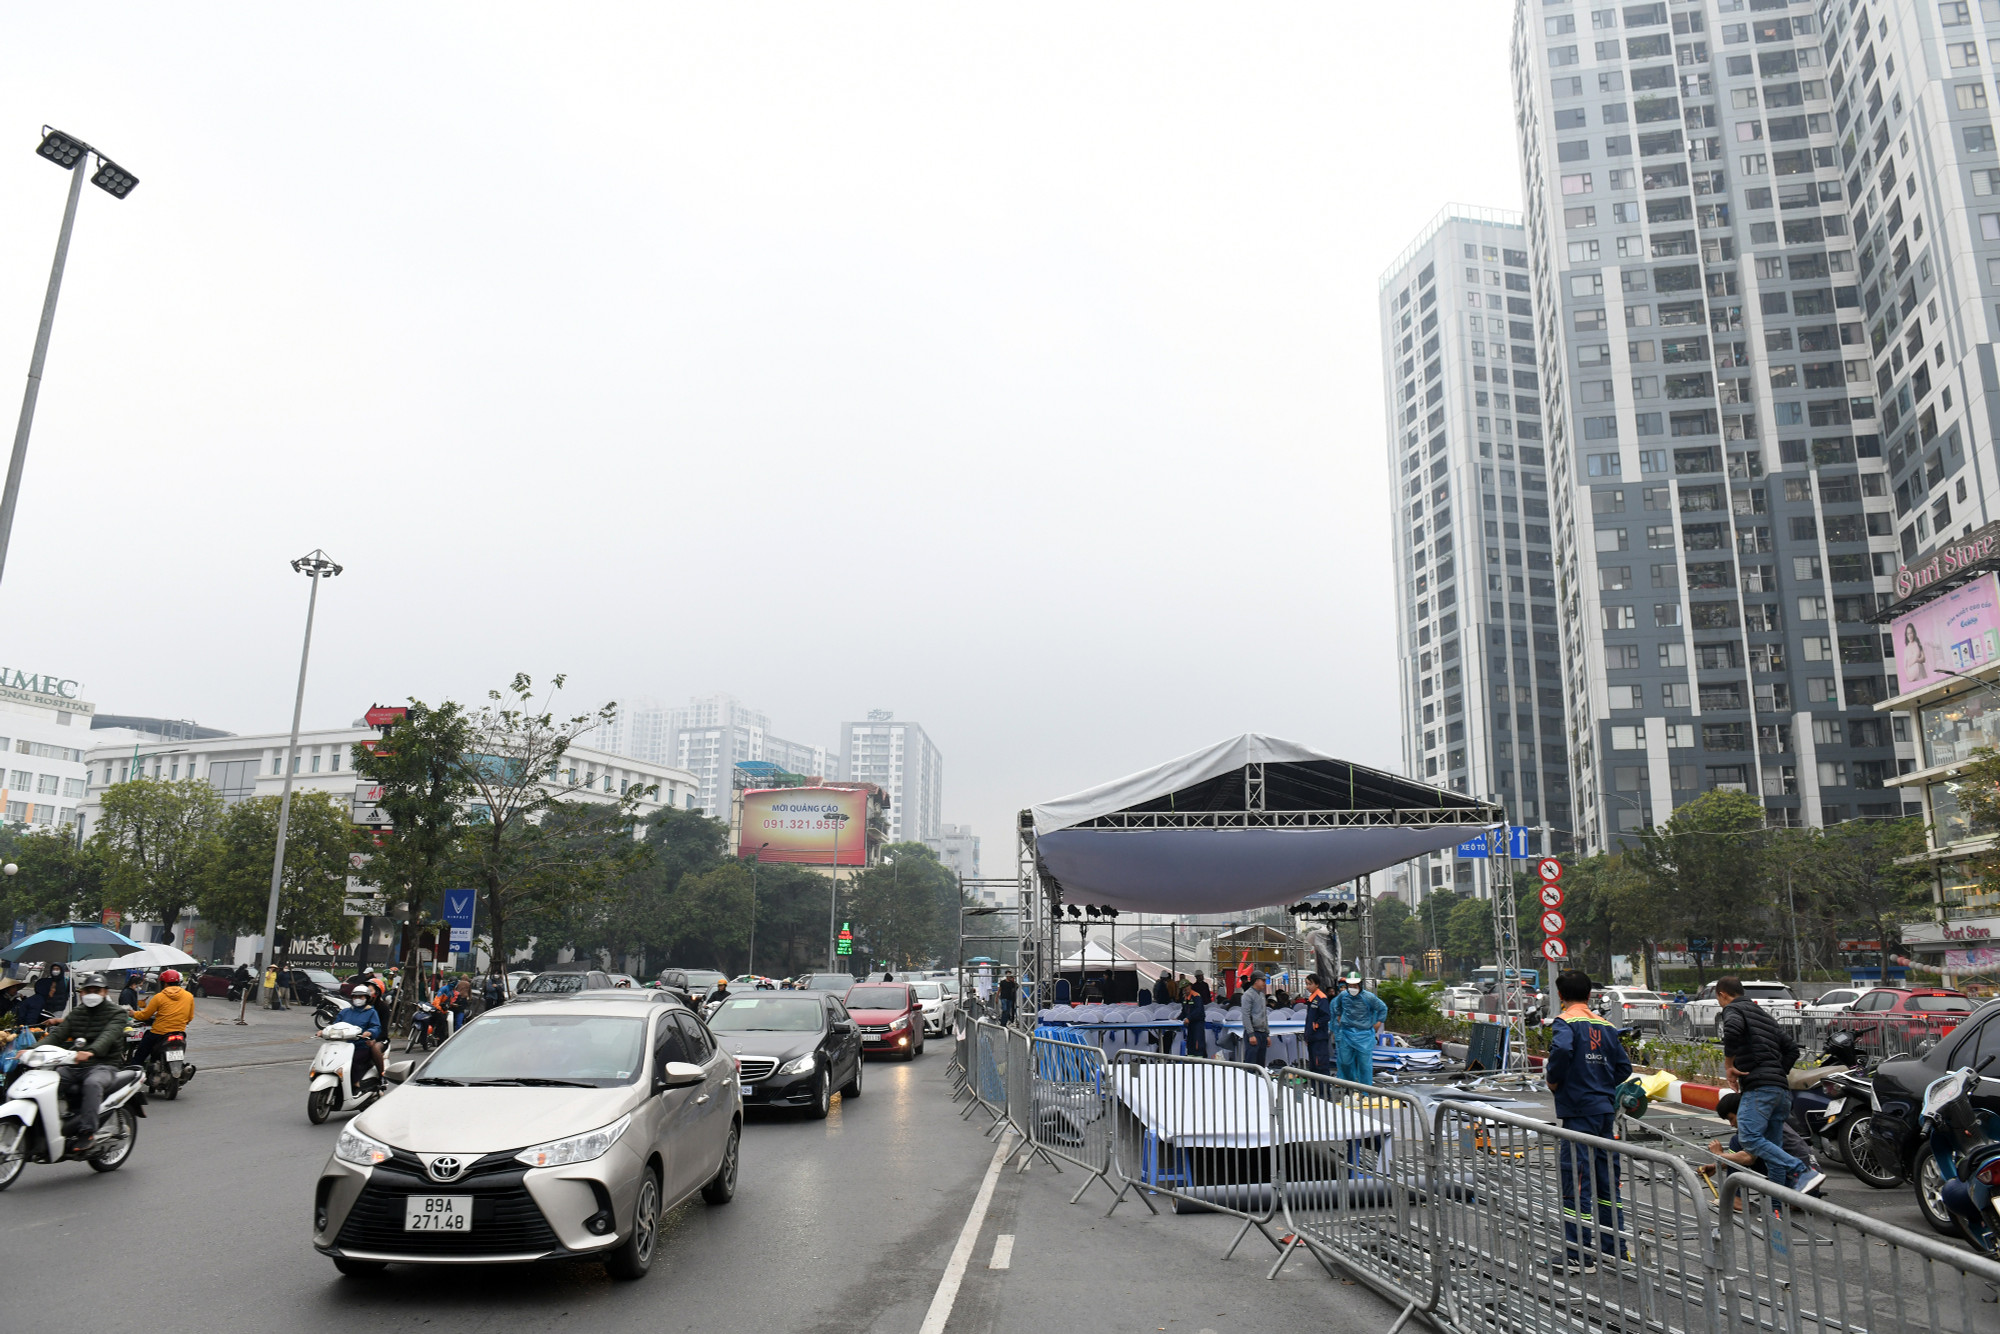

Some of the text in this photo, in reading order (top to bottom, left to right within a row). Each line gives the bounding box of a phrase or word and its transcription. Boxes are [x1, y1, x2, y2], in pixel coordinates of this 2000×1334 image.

[1896, 536, 1993, 599] Suri Store
[34, 695, 90, 713] HOSPITAL
[772, 803, 838, 812] MỜI QUẢNG CÁO
[763, 820, 845, 830] 091.321.9555
[1471, 842, 1475, 851] Ô
[1477, 842, 1486, 850] TÔ
[1942, 925, 1991, 940] Suri Store
[425, 1198, 453, 1213] 89A
[412, 1214, 464, 1229] 271.48
